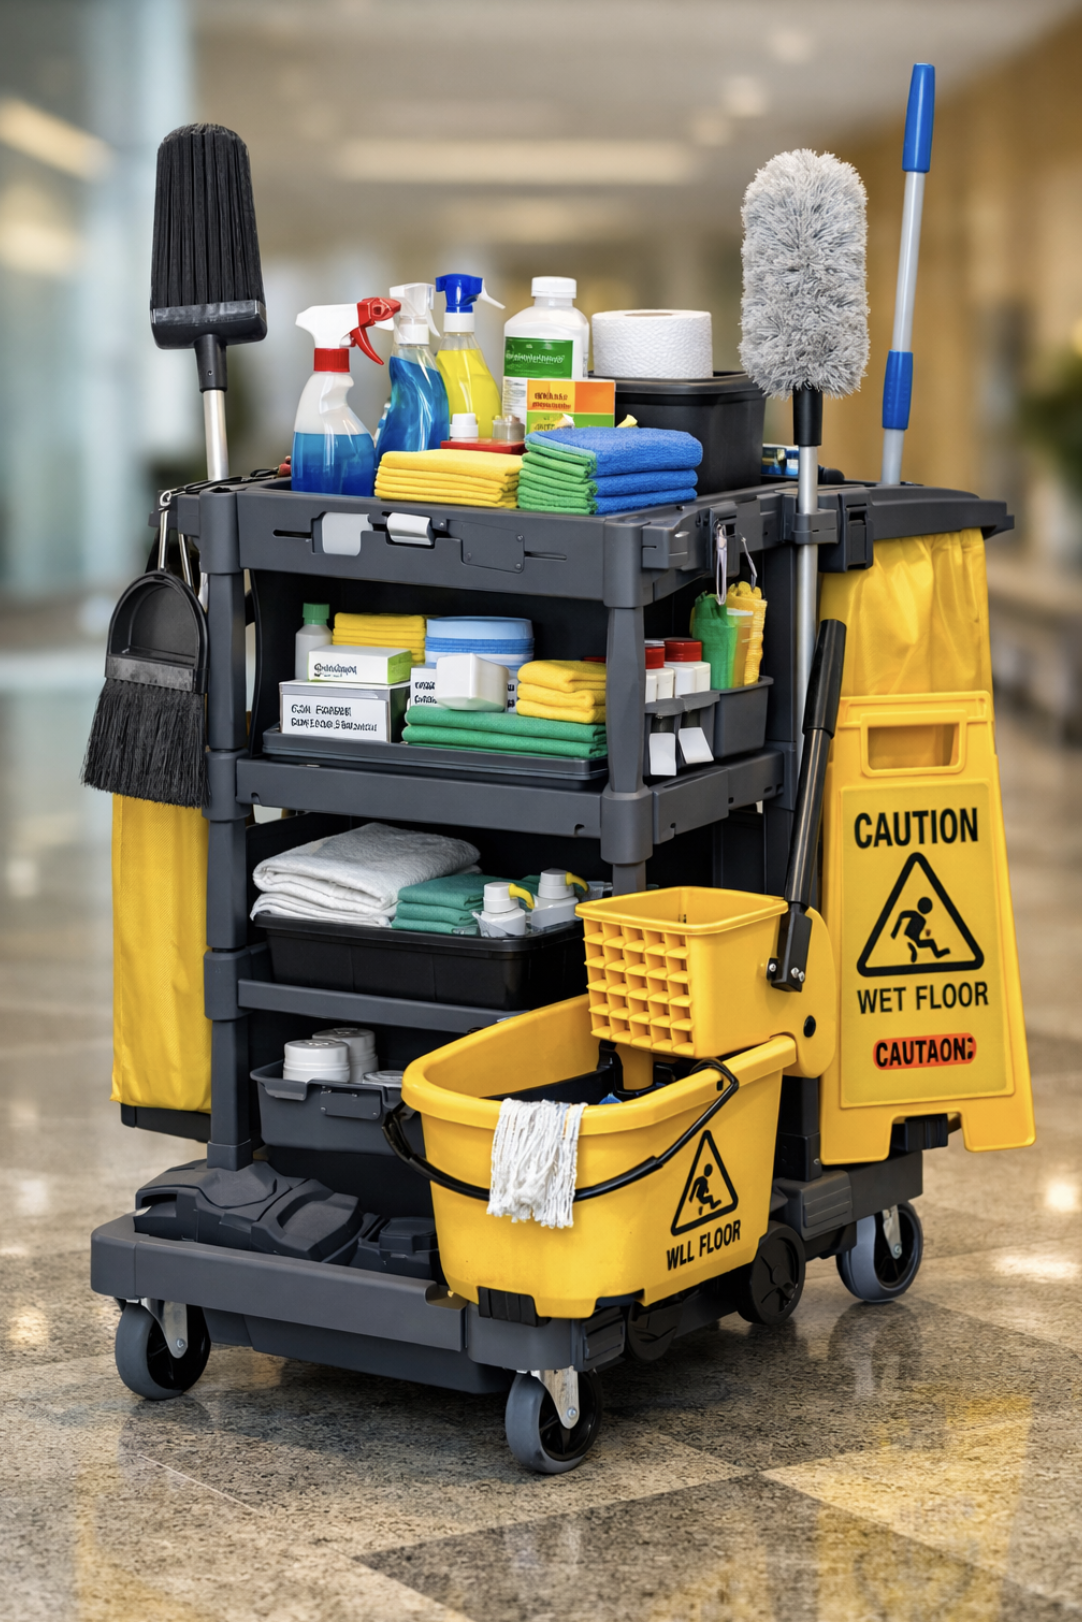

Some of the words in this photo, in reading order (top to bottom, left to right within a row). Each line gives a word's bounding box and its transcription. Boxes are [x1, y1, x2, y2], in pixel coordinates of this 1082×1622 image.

[854, 808, 979, 849] CAUTION
[857, 986, 906, 1014] WET
[916, 981, 989, 1010] FLOOR
[666, 1240, 695, 1271] WLL
[699, 1219, 741, 1257] FLOOR
